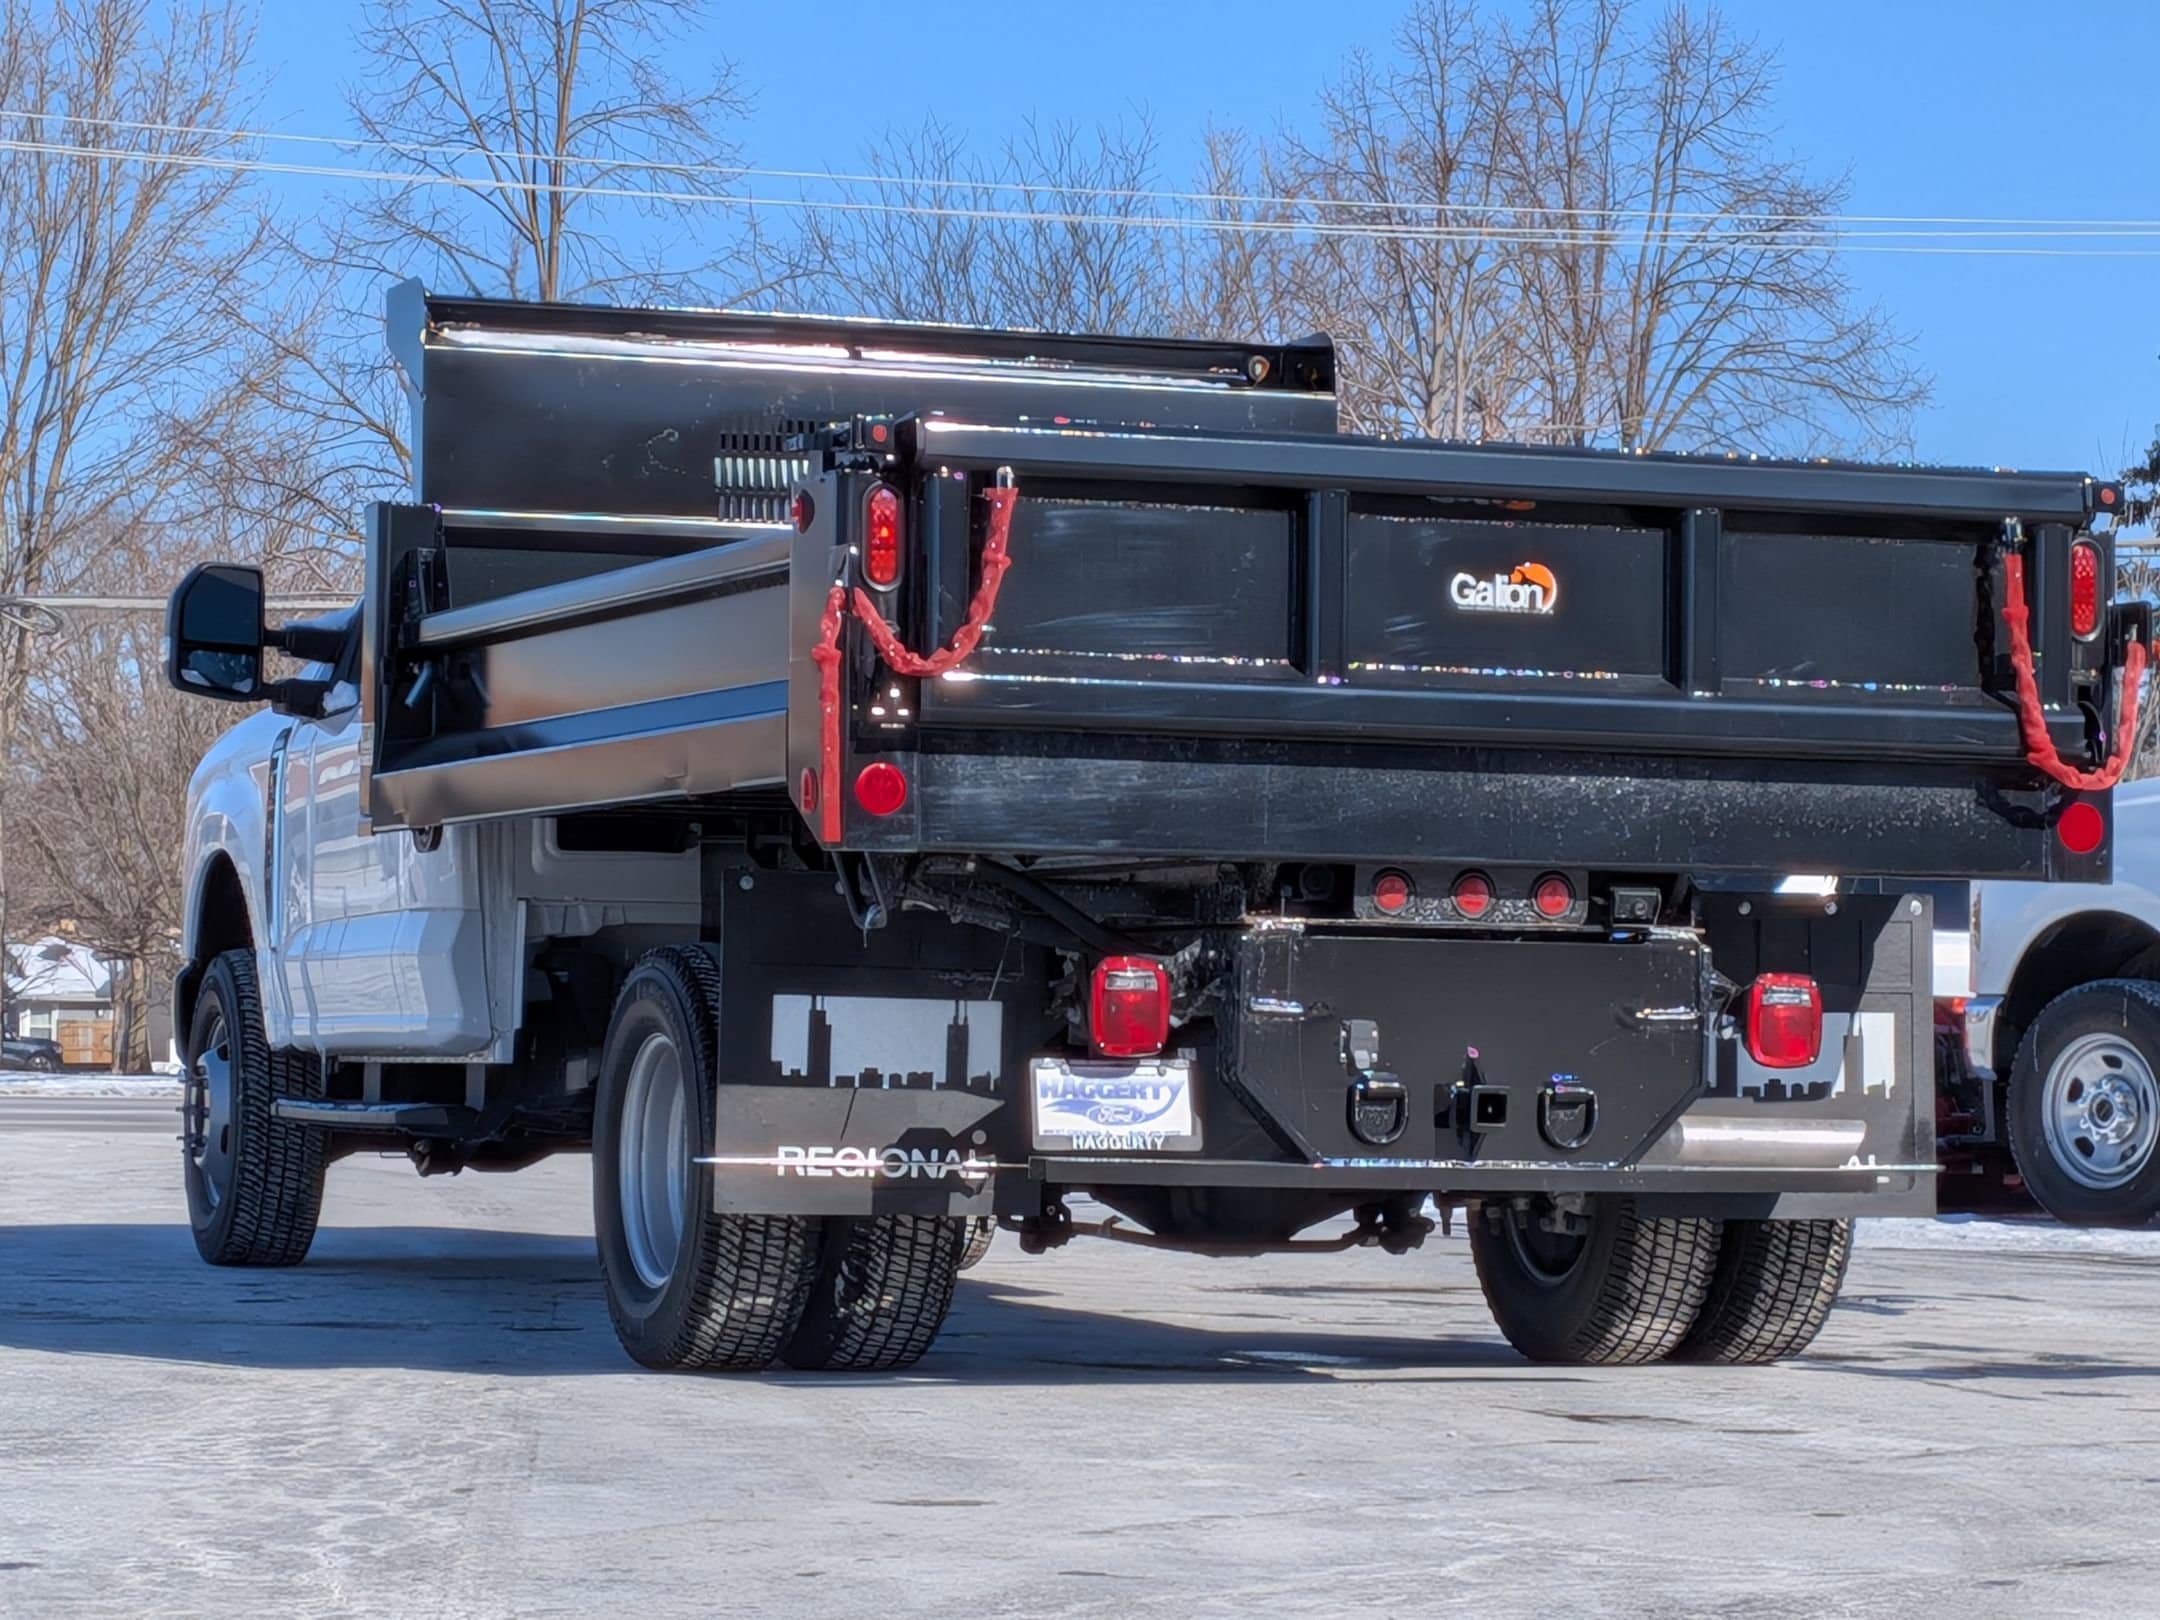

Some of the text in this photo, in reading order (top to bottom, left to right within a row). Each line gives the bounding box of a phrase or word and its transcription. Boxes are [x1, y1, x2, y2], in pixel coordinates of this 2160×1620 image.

[1450, 572, 1544, 609] Galion
[1039, 1078, 1185, 1100] HAGGERTY
[777, 1146, 989, 1178] REGIONAL
